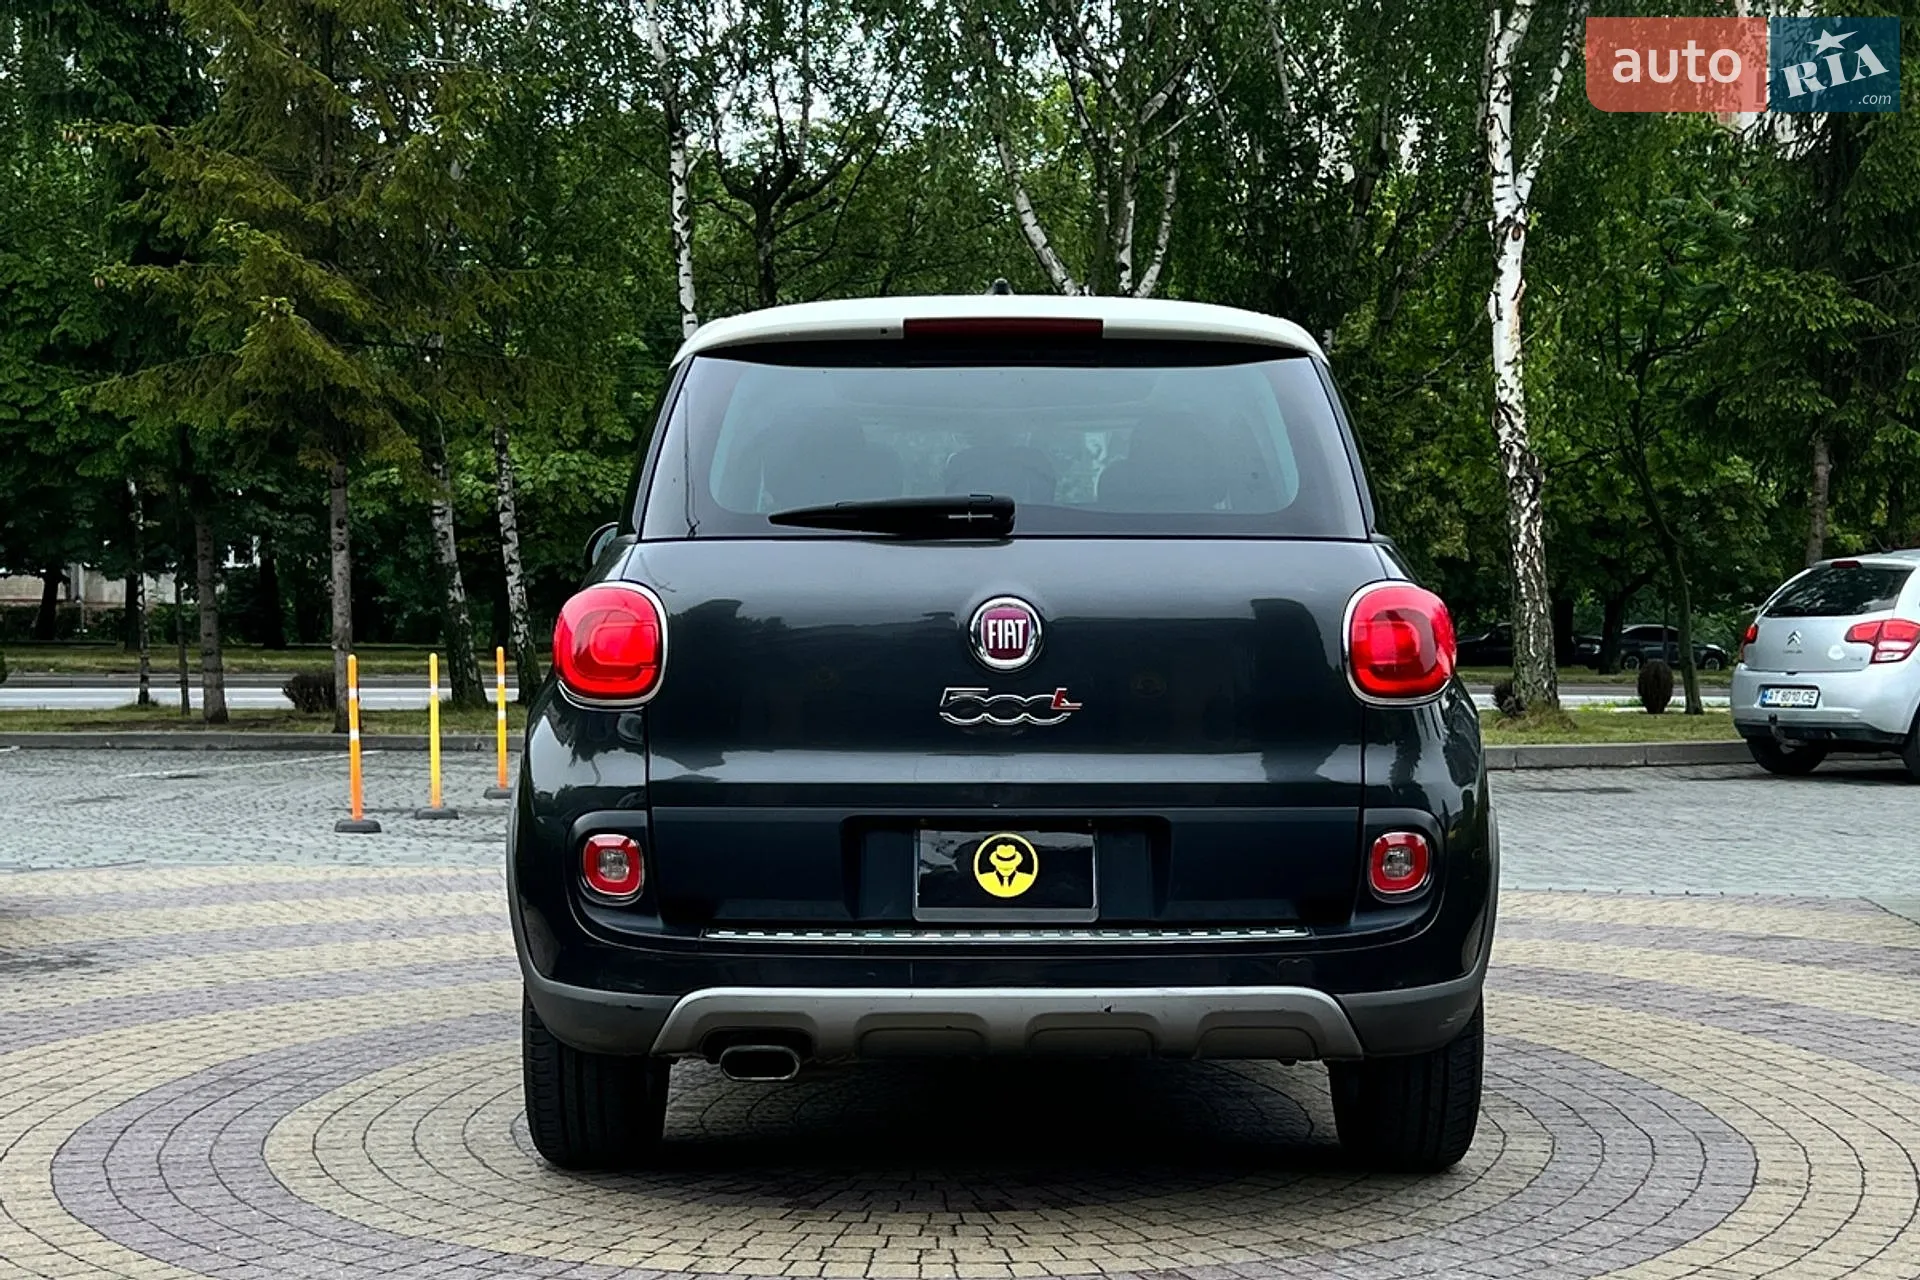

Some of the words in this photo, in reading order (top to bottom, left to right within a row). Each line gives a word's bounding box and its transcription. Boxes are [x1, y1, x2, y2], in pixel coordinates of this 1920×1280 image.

[988, 619, 1027, 649] FIAT
[939, 687, 1083, 725] 500L
[1767, 690, 1780, 701] AT
[1801, 691, 1816, 703] CE
